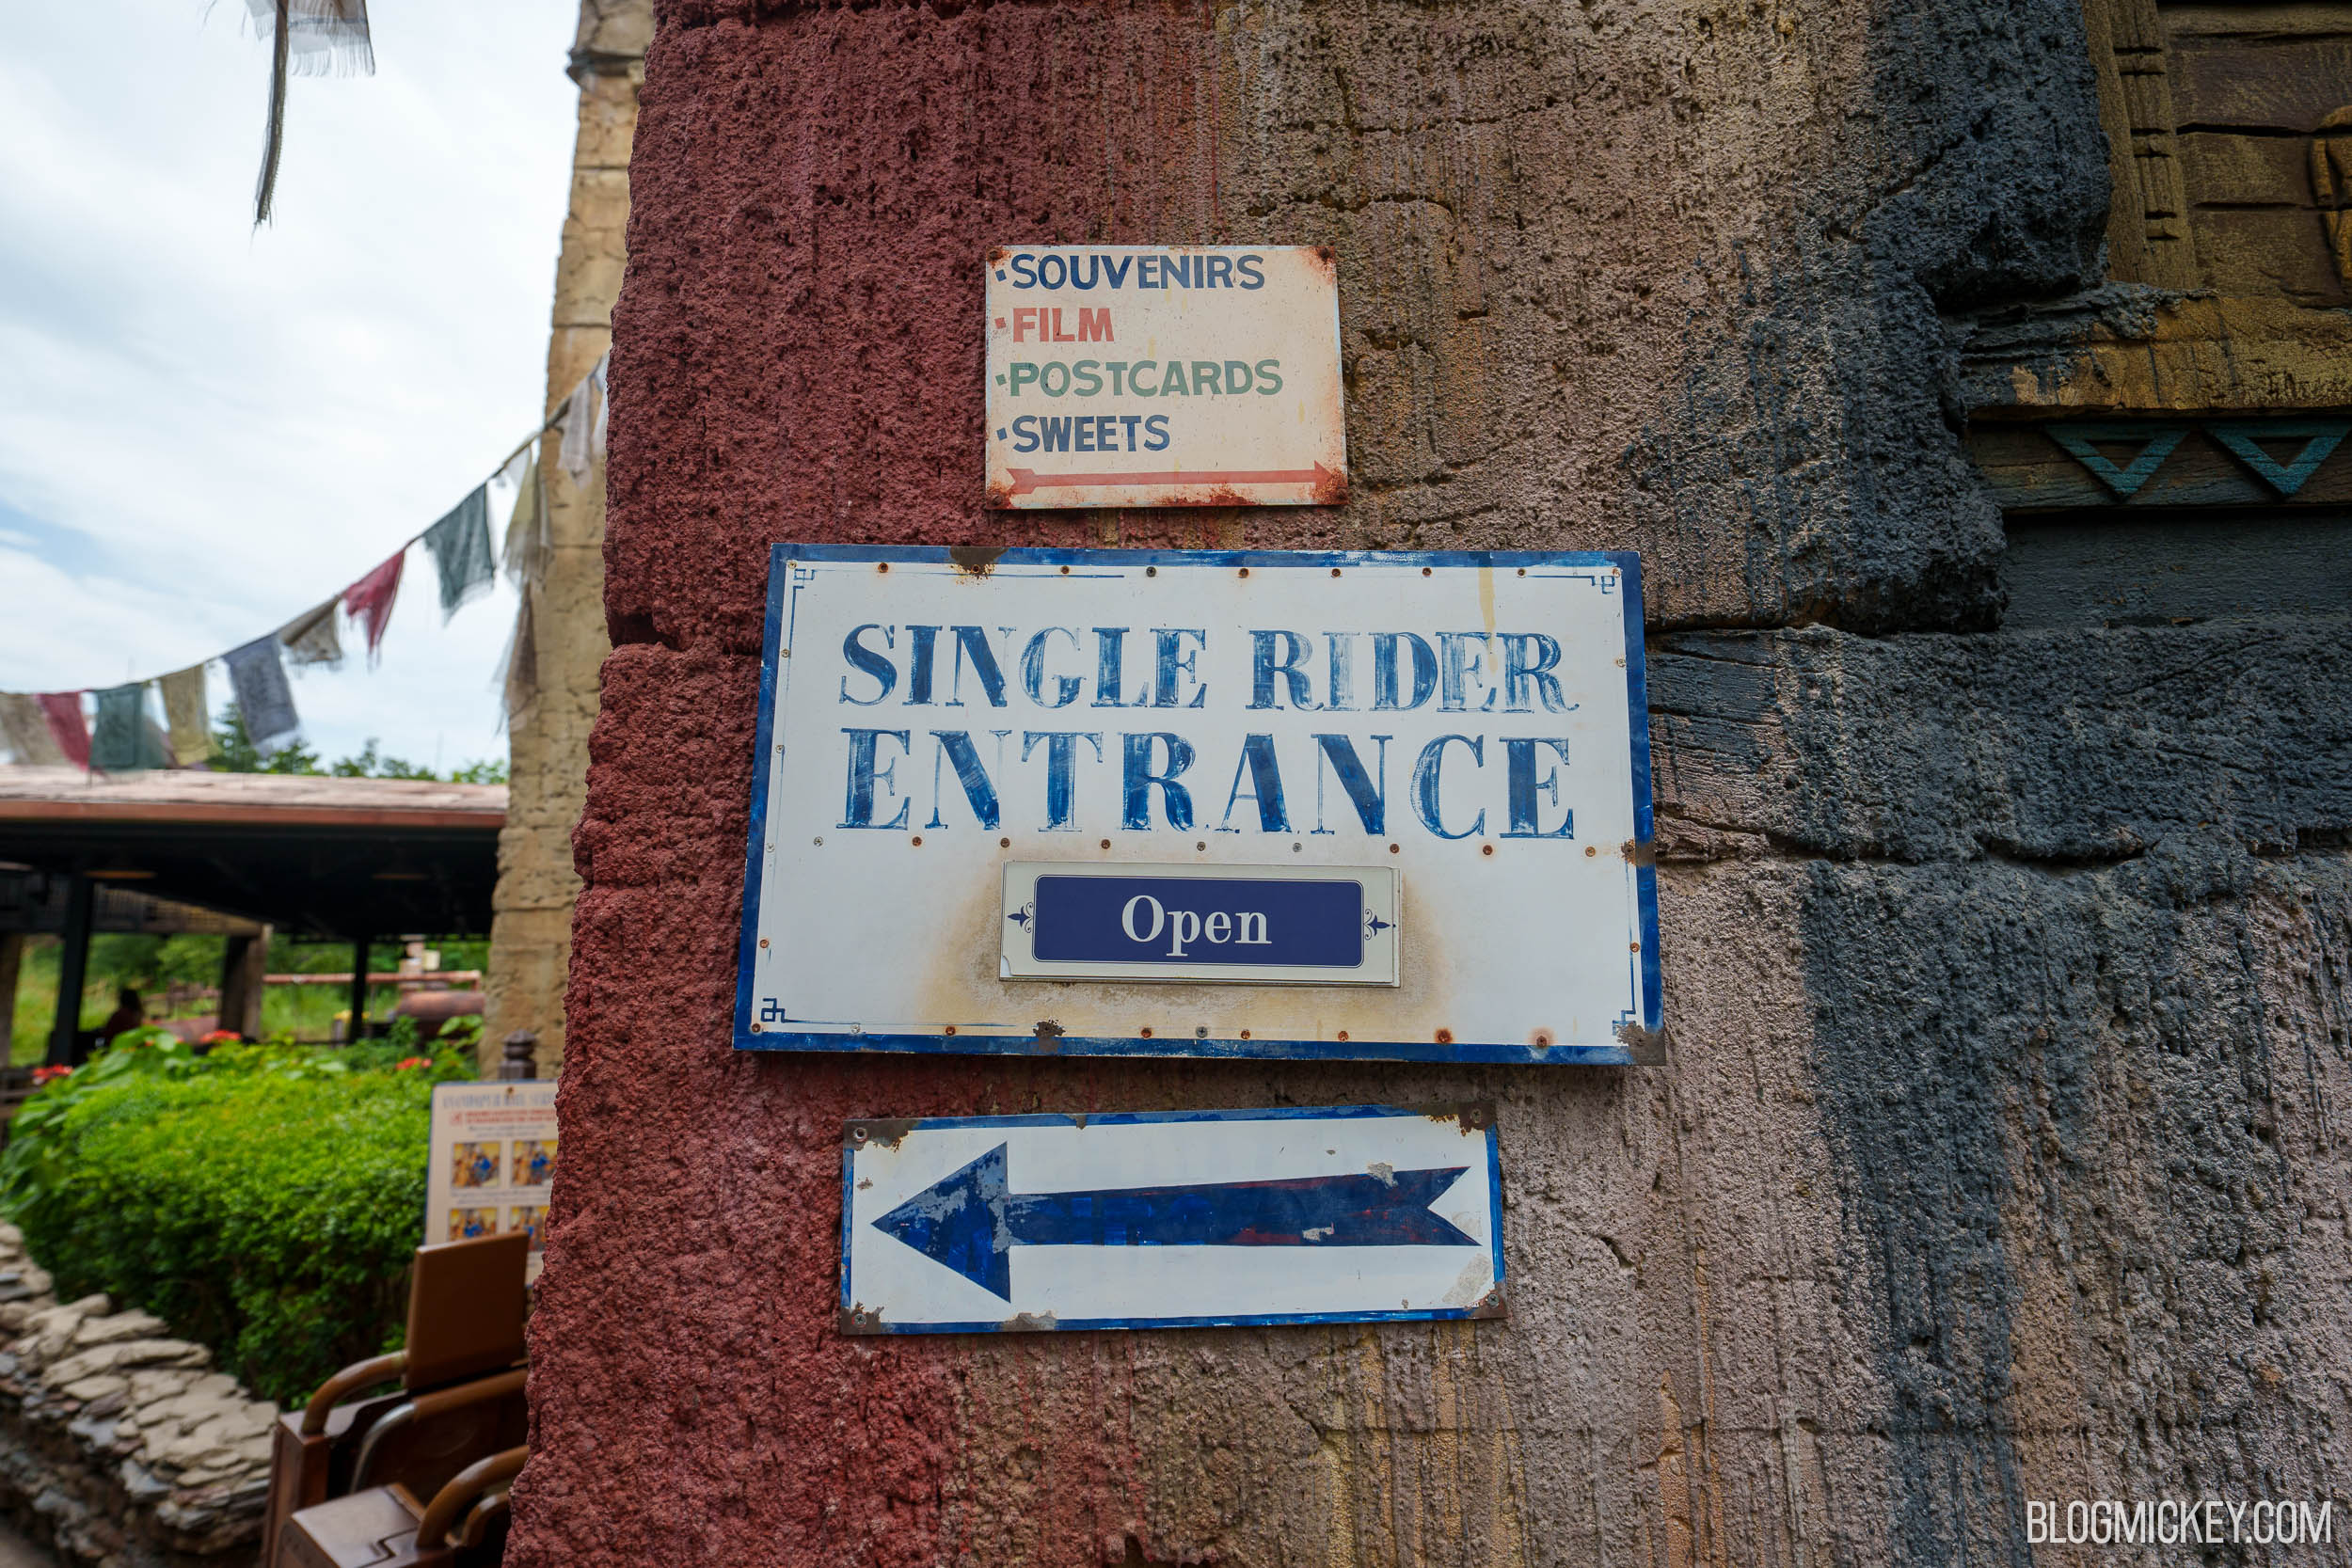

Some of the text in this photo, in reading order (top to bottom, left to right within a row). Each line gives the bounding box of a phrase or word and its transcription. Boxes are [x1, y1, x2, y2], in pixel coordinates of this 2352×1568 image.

[1010, 253, 1265, 290] SOUVENIRS
[1012, 308, 1115, 342] FILM
[1009, 359, 1283, 397] POSTCARDS
[1011, 415, 1170, 452] SWEETS
[838, 624, 1580, 715] SINGLE RIDER
[835, 728, 1576, 841] ENTRANCE
[1120, 894, 1273, 960] Open
